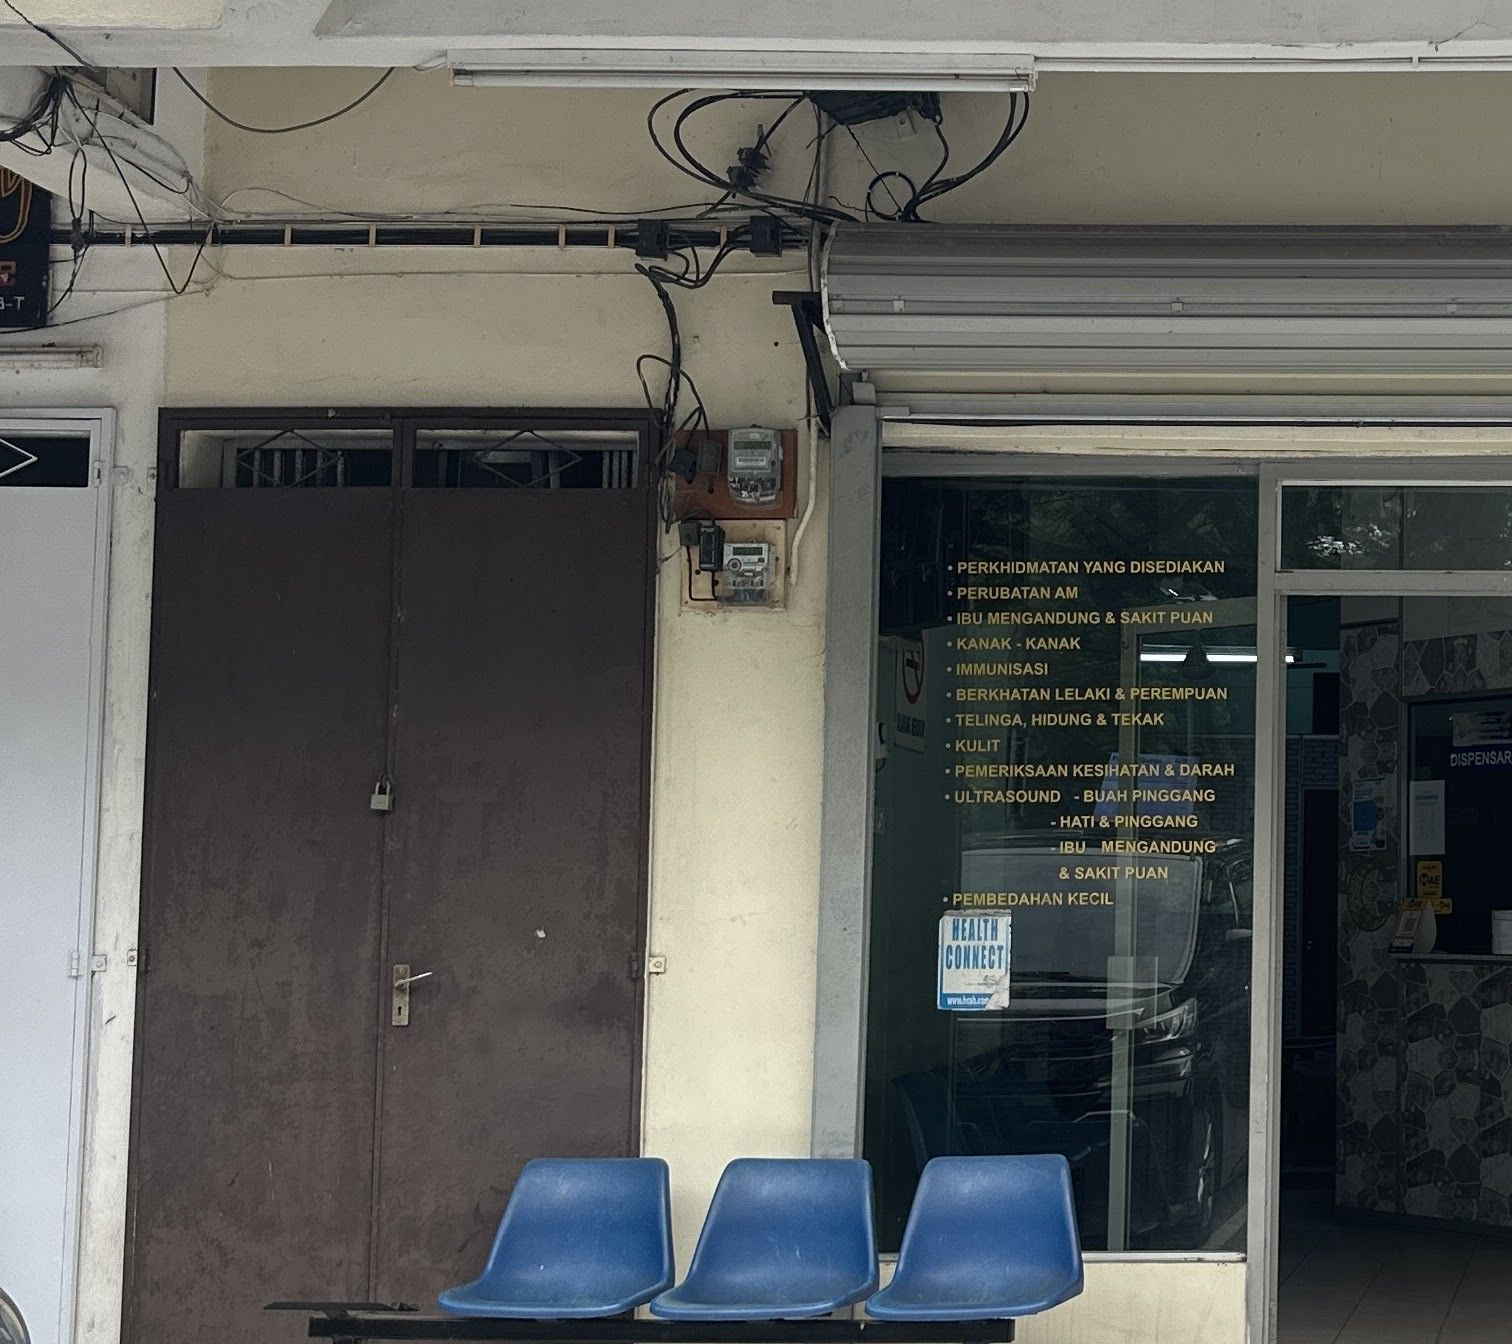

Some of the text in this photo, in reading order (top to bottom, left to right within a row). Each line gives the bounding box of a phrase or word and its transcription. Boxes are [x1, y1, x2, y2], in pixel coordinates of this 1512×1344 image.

[957, 560, 1225, 575] PERKHIDMATAN YANG DISEDIAKAN
[957, 587, 1078, 600] PERUBATAN AM
[957, 611, 1213, 625] IBU MENGANDUNG & SAKIT PUAN
[957, 638, 1012, 651] KANAK
[1026, 637, 1081, 650] KANAK
[956, 663, 1048, 676] IMMUNISASI
[956, 687, 1227, 702] BERKHATAN LELAKI & PEREMPUAN
[956, 713, 1164, 728] TELINGA, HIDUNG & TEKAK
[955, 739, 1001, 752] KULIT
[955, 763, 1235, 778] PEMERIKSAAN KESIHATAN & DARAH
[955, 790, 1061, 803] ULTRASOUND
[1084, 789, 1129, 803] BUAH
[1133, 789, 1216, 803] PINGGANG
[1060, 815, 1095, 828] HATI
[1100, 815, 1110, 828] &
[1115, 815, 1198, 828] PINGGANG
[1059, 841, 1086, 854] IBU
[1102, 840, 1216, 854] MENGANDUNG
[1059, 866, 1168, 880] & SAKIT PUAN
[953, 892, 1114, 906] PEMBEDAHAN KECIL
[952, 918, 998, 941] HEALTH
[945, 945, 1004, 969] CONNECT
